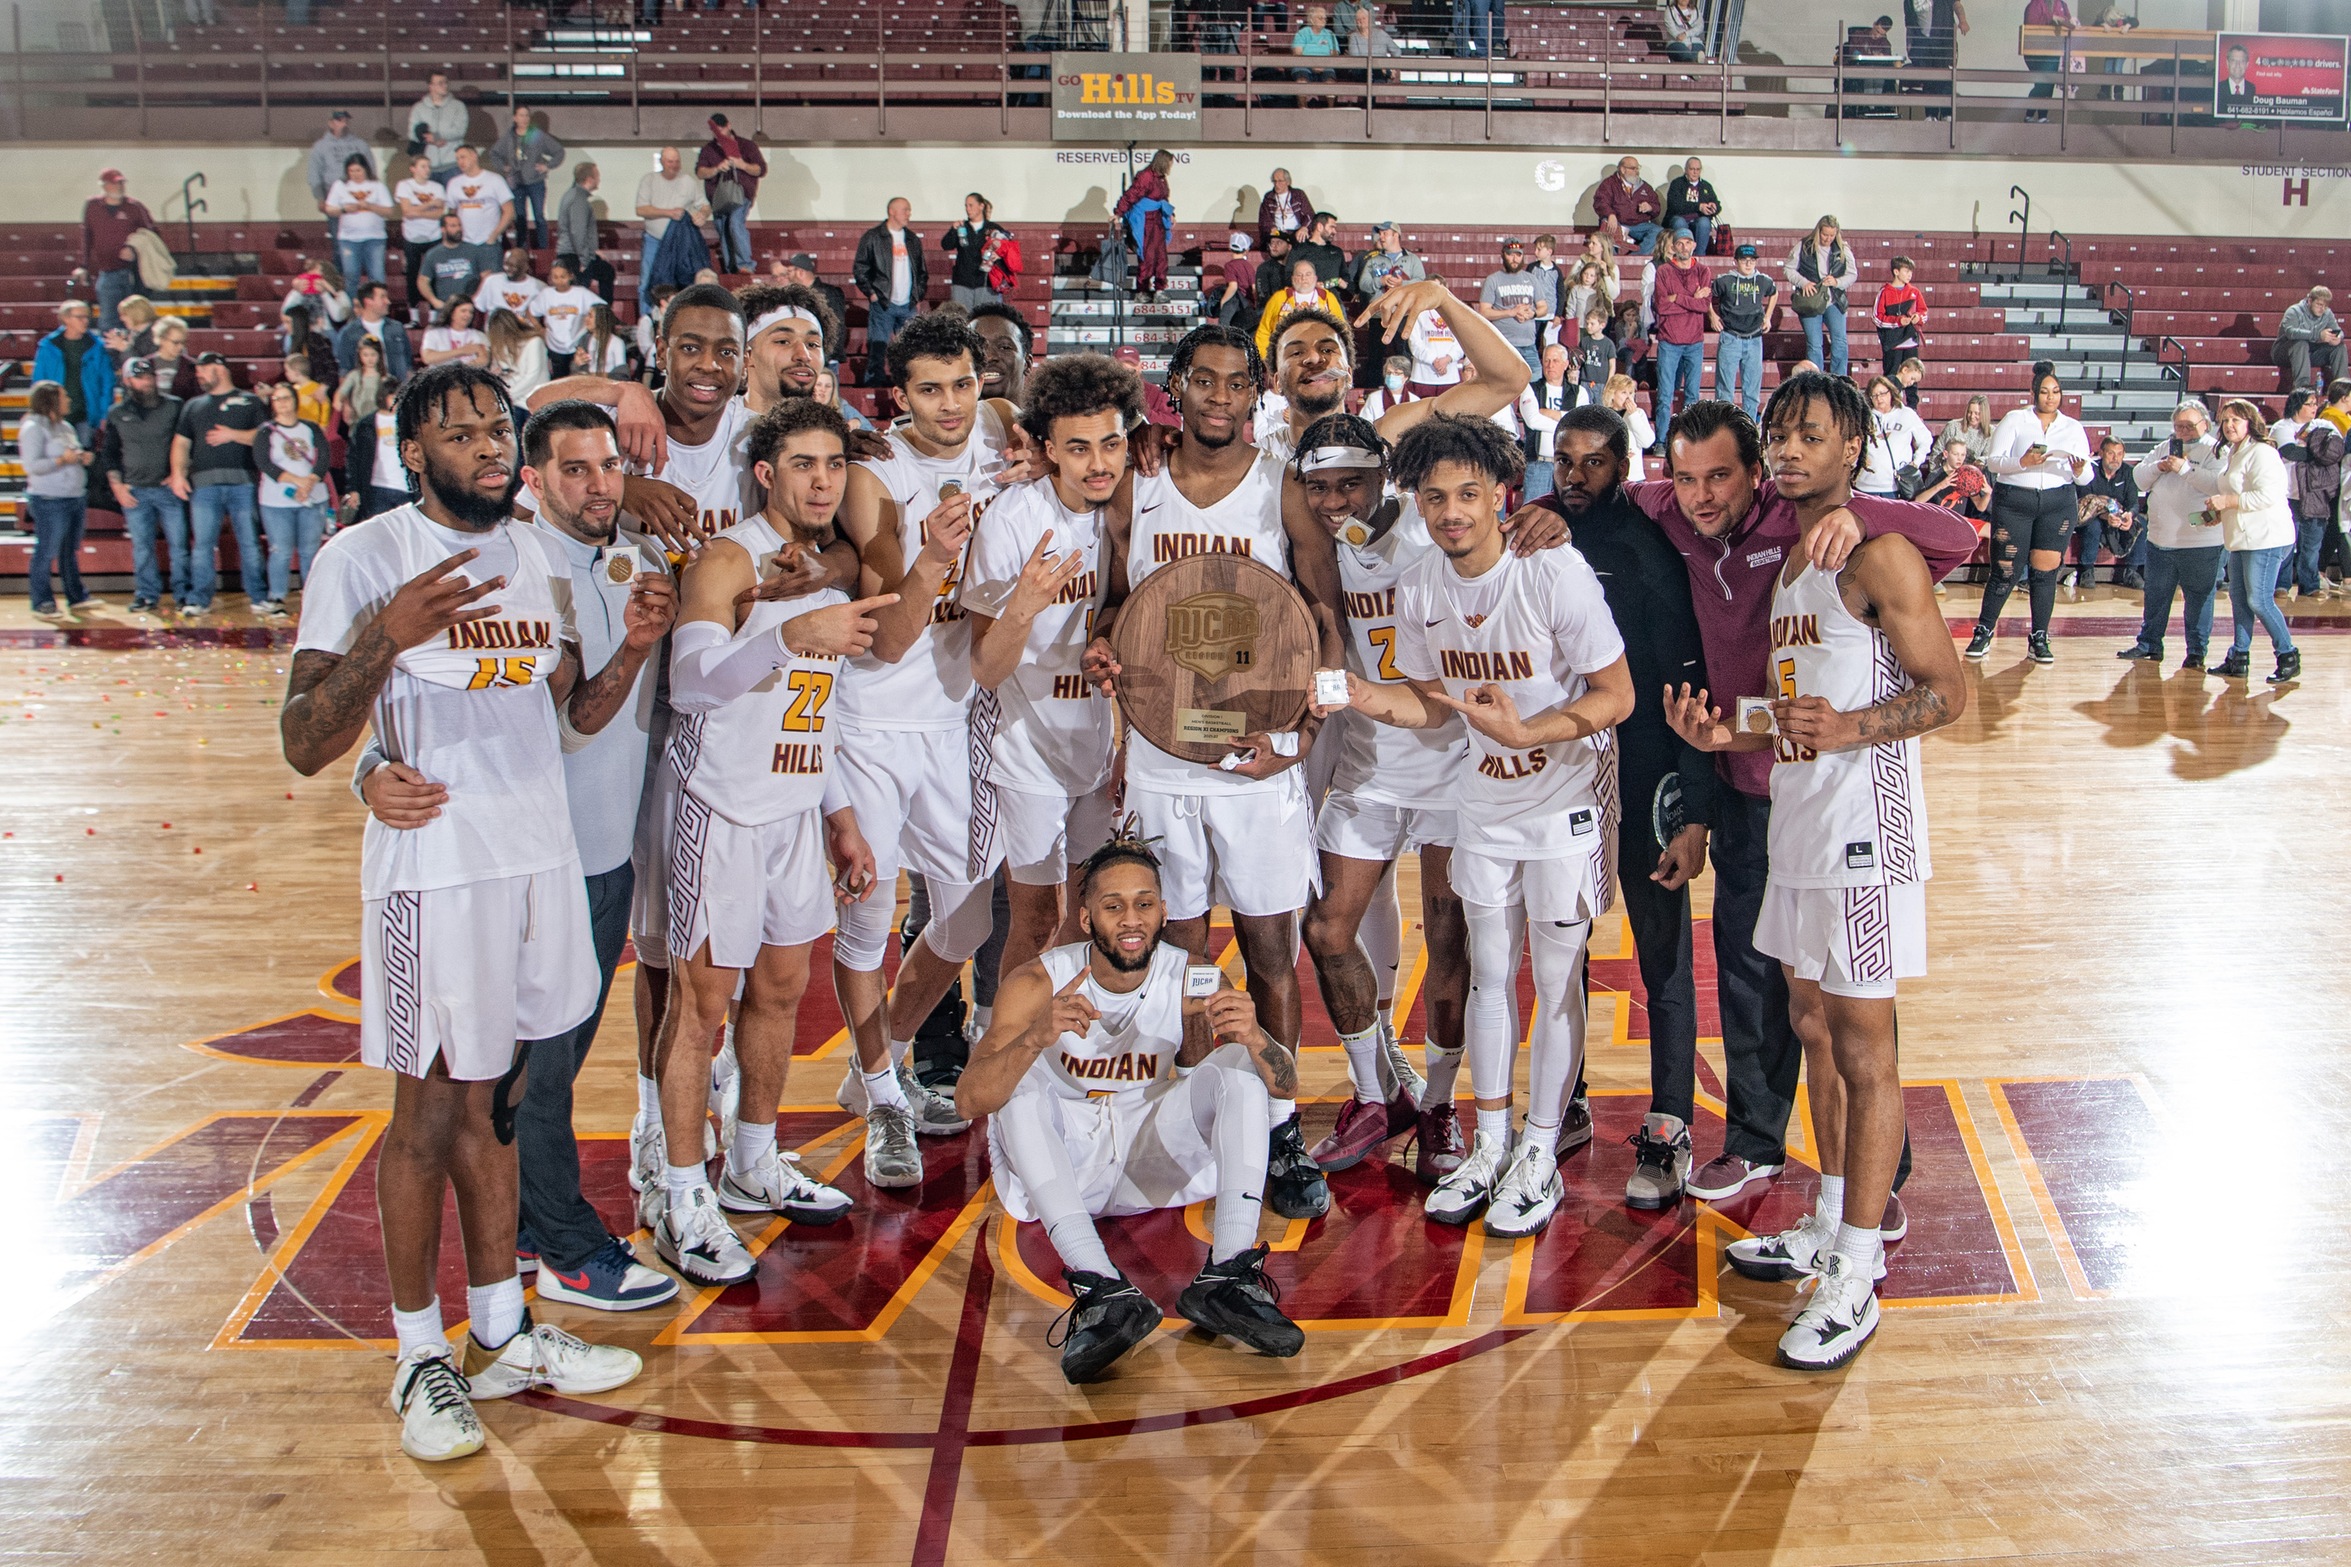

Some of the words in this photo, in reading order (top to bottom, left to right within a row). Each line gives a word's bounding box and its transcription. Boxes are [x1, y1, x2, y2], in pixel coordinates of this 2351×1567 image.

[2315, 59, 2341, 69] drivers.
[1058, 75, 1081, 86] GO
[1080, 73, 1176, 105] Hills
[1175, 93, 1195, 104] TV
[2253, 96, 2274, 106] Doug
[2275, 97, 2308, 105] Bauman
[1057, 110, 1112, 119] Download
[1114, 110, 1133, 119] the
[1135, 110, 1157, 121] App
[1160, 110, 1197, 121] Today!
[2276, 107, 2307, 115] Hablamos
[2308, 108, 2334, 117] Español
[1056, 152, 1128, 164] RESERVED
[1134, 152, 1191, 164] SENG
[1535, 160, 1565, 192] G
[2242, 164, 2297, 177] STUDENT
[2283, 178, 2309, 207] H
[1959, 262, 1979, 270] ROW
[1498, 284, 1534, 298] WARRIOR
[1133, 305, 1191, 315] 684-5151
[1153, 533, 1251, 563] INDIAN
[1746, 550, 1766, 562] INDIAN
[1766, 546, 1781, 556] HILLS
[1343, 588, 1396, 619] NDIA
[448, 620, 553, 649] INDIAN
[1185, 651, 1226, 660] REGION
[1235, 651, 1250, 664] 11
[1440, 650, 1533, 681] INDIAN
[465, 656, 537, 691] 15
[1052, 675, 1092, 699] HIL
[782, 669, 834, 732] 22
[1856, 845, 1863, 853] L
[1060, 1051, 1158, 1081] INDIAN
